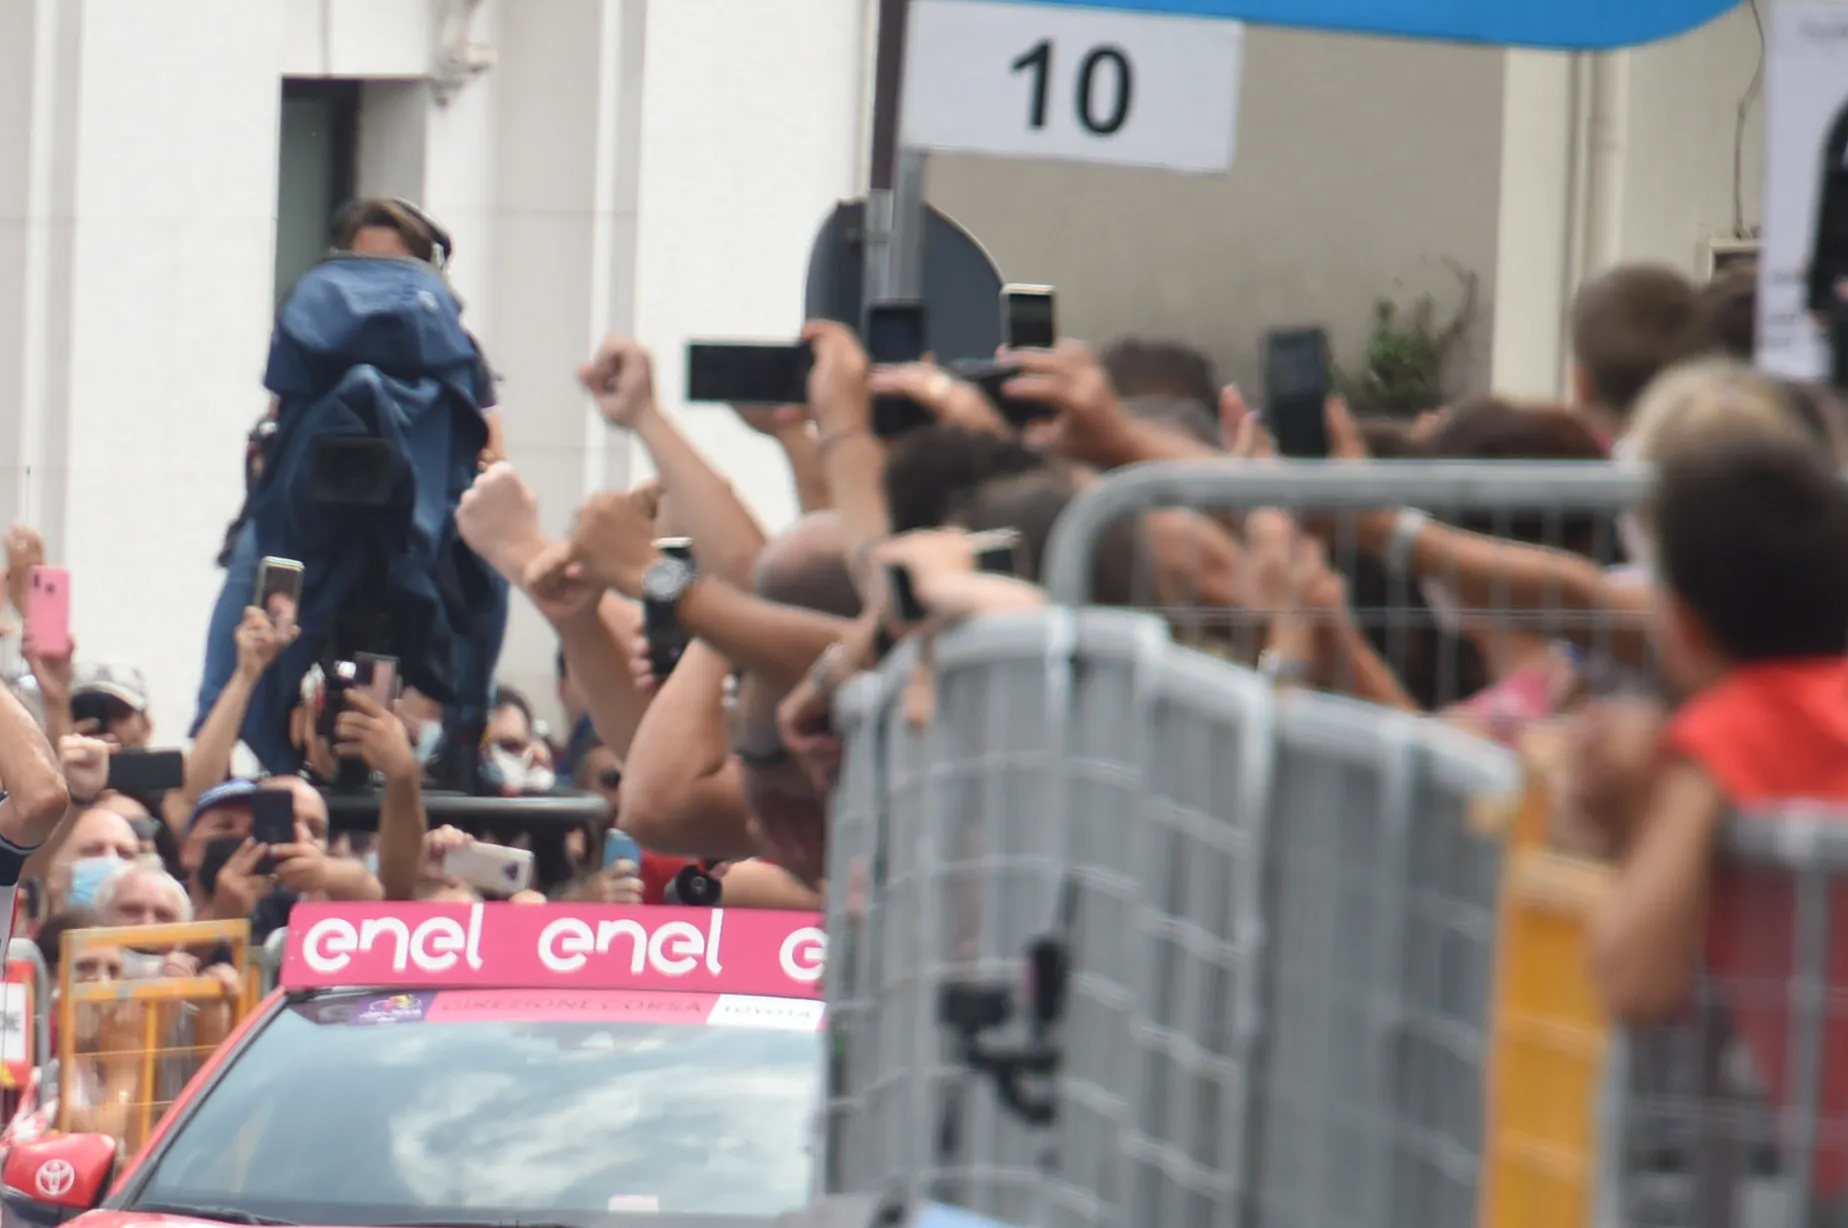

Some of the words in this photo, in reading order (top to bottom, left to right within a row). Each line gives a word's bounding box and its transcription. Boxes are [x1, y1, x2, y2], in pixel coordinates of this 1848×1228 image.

[1010, 37, 1134, 136] 10
[302, 902, 485, 974] enel
[537, 908, 725, 977] enel
